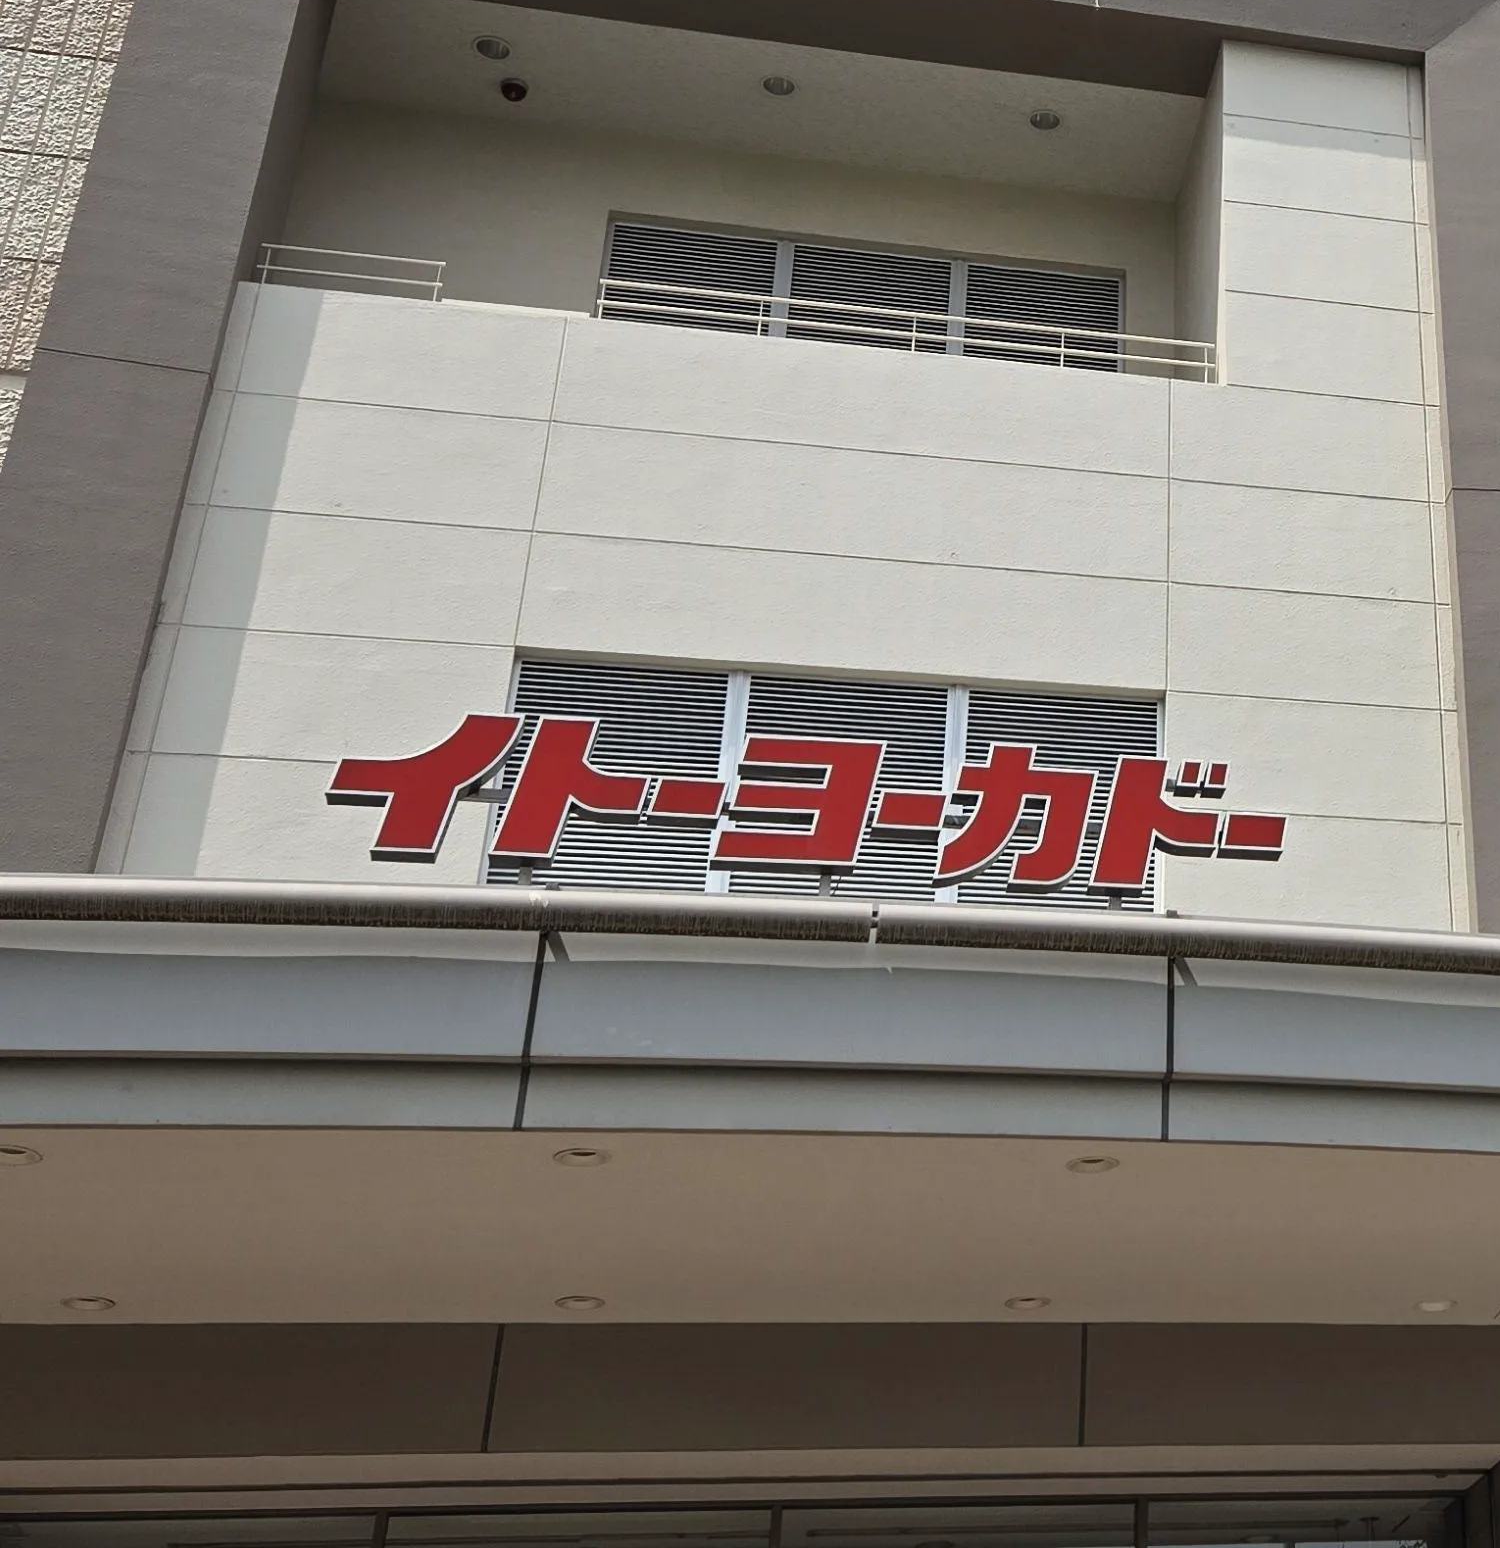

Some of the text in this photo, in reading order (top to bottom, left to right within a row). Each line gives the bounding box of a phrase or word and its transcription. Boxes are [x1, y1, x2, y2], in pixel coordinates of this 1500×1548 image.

[327, 713, 1288, 897] イトーヨーカドー
